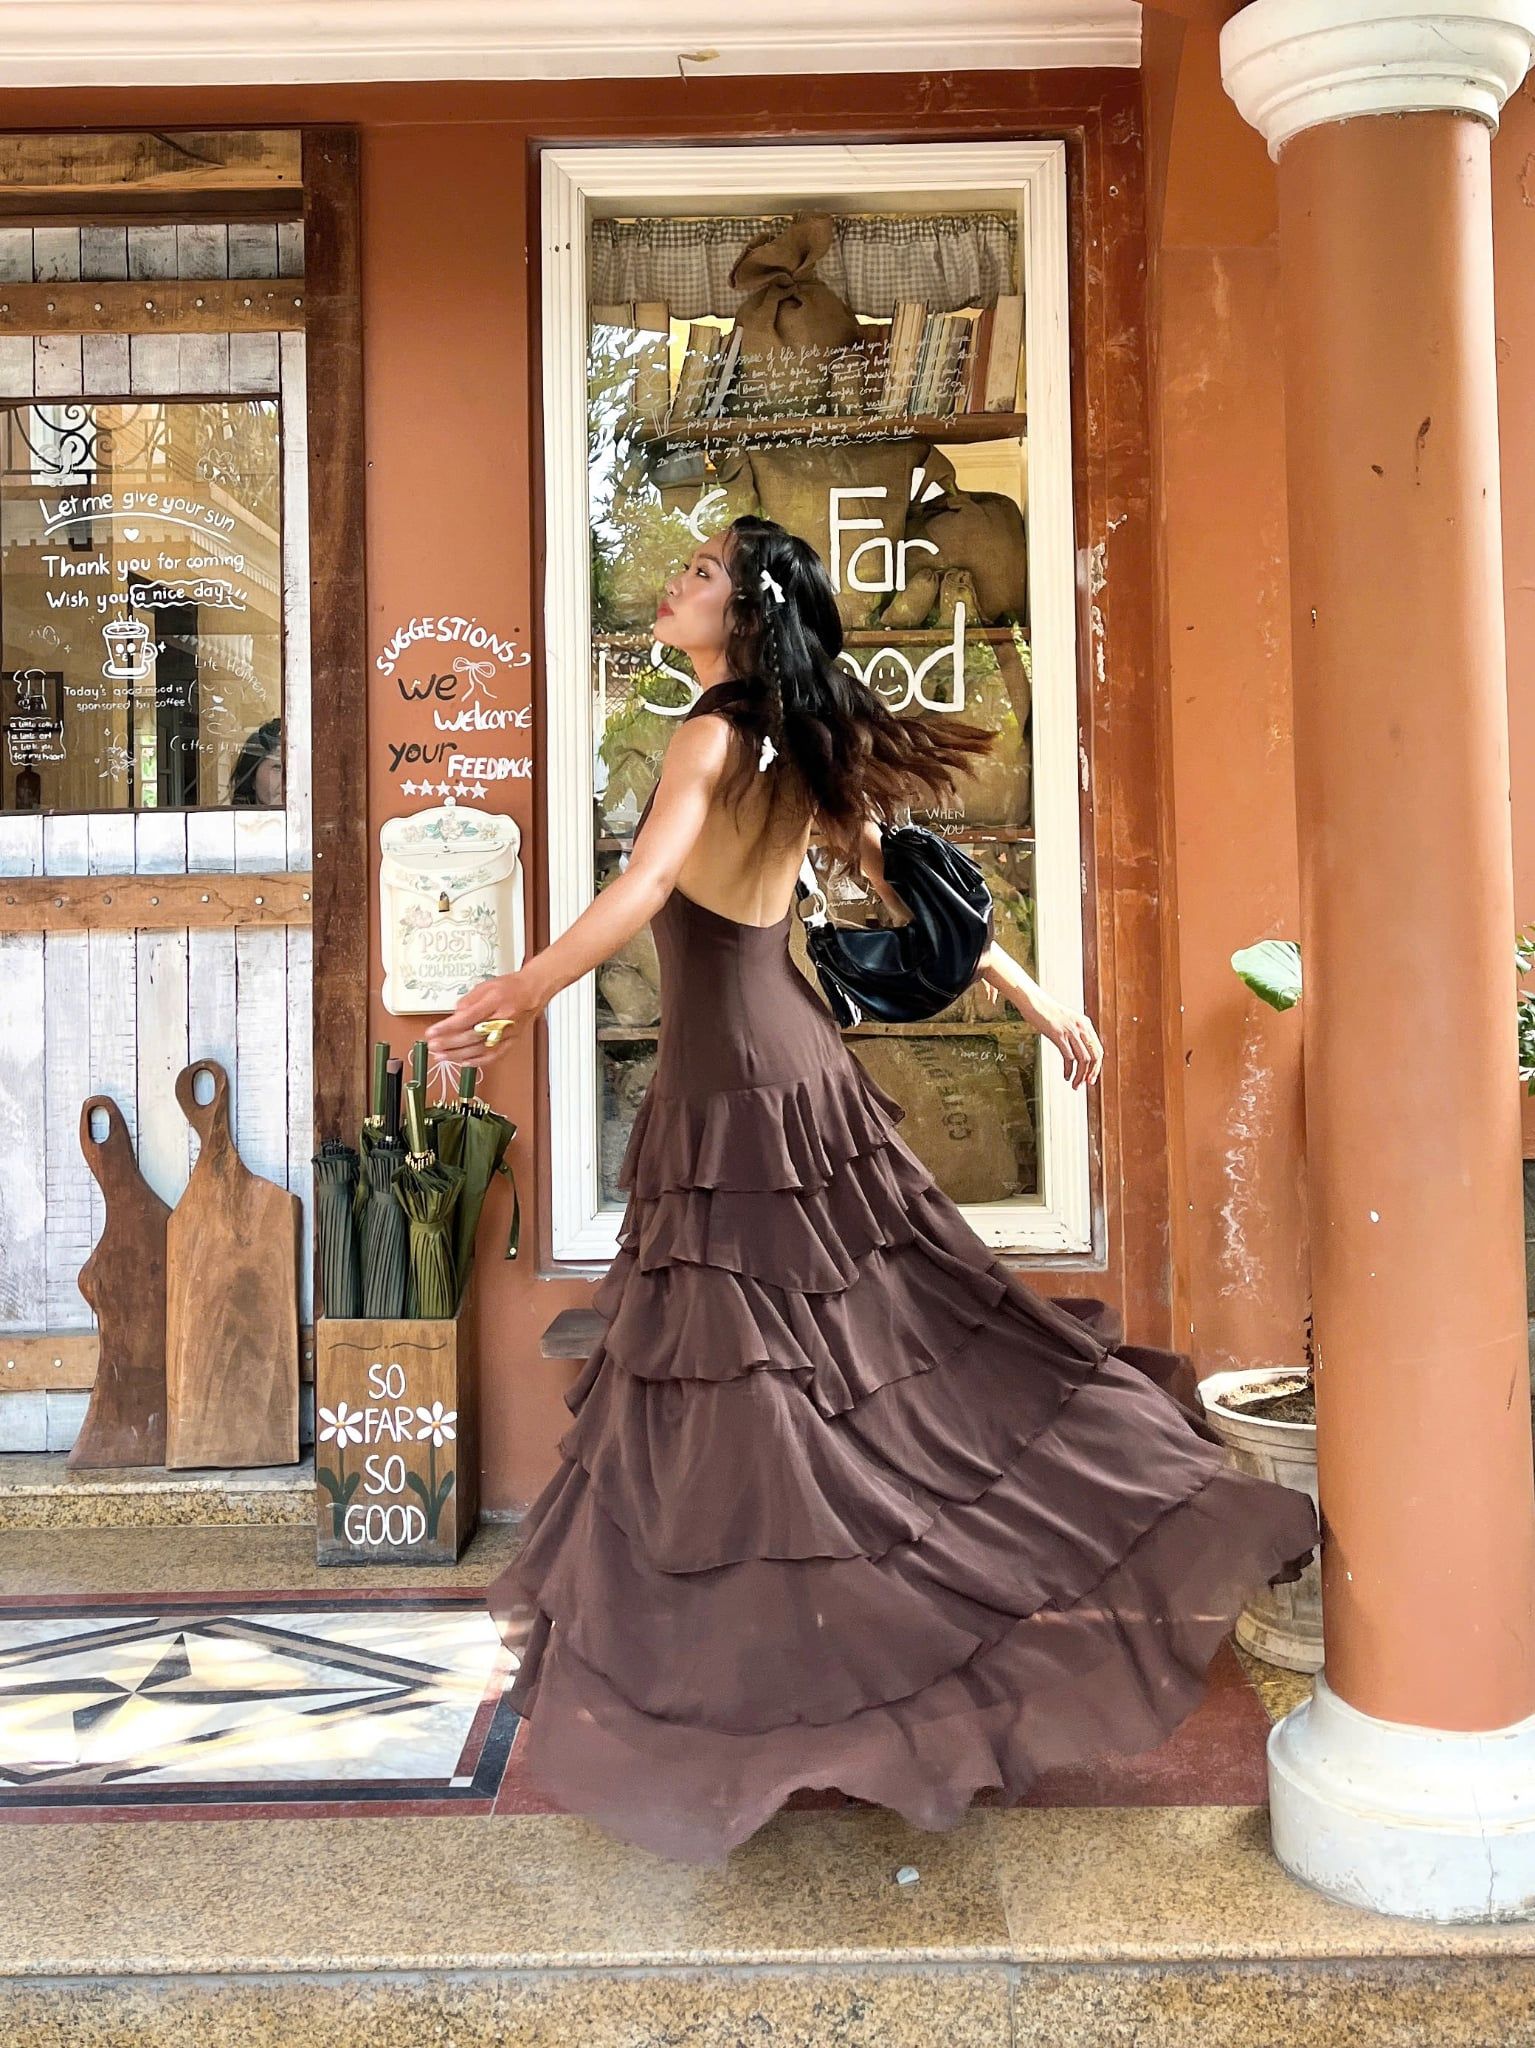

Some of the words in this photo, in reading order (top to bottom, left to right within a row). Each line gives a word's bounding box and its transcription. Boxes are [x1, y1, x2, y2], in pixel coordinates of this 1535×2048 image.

[39, 495, 78, 524] Let
[82, 493, 113, 512] me
[122, 490, 158, 509] give
[159, 493, 205, 516] your
[204, 509, 235, 532] sun
[829, 486, 940, 594] Far
[41, 553, 110, 577] Thank
[117, 556, 151, 582] you
[157, 552, 181, 570] for
[186, 554, 244, 573] coming
[46, 590, 88, 608] Wish
[97, 593, 128, 613] you
[136, 591, 146, 601] a
[153, 587, 185, 600] nice
[194, 583, 224, 603] day
[63, 684, 107, 700] Today's
[113, 686, 142, 697] good
[76, 700, 131, 712] sponsored
[154, 698, 185, 708] coffee
[388, 742, 458, 772] your
[447, 754, 533, 781] FEEDBACK
[925, 805, 966, 820] WHEN
[940, 824, 964, 837] YOU
[418, 930, 476, 953] POST
[418, 962, 478, 977] COURIER
[368, 1363, 406, 1400] SO
[364, 1406, 414, 1444] FAR
[363, 1454, 406, 1495] SO
[344, 1504, 427, 1545] GOOD
